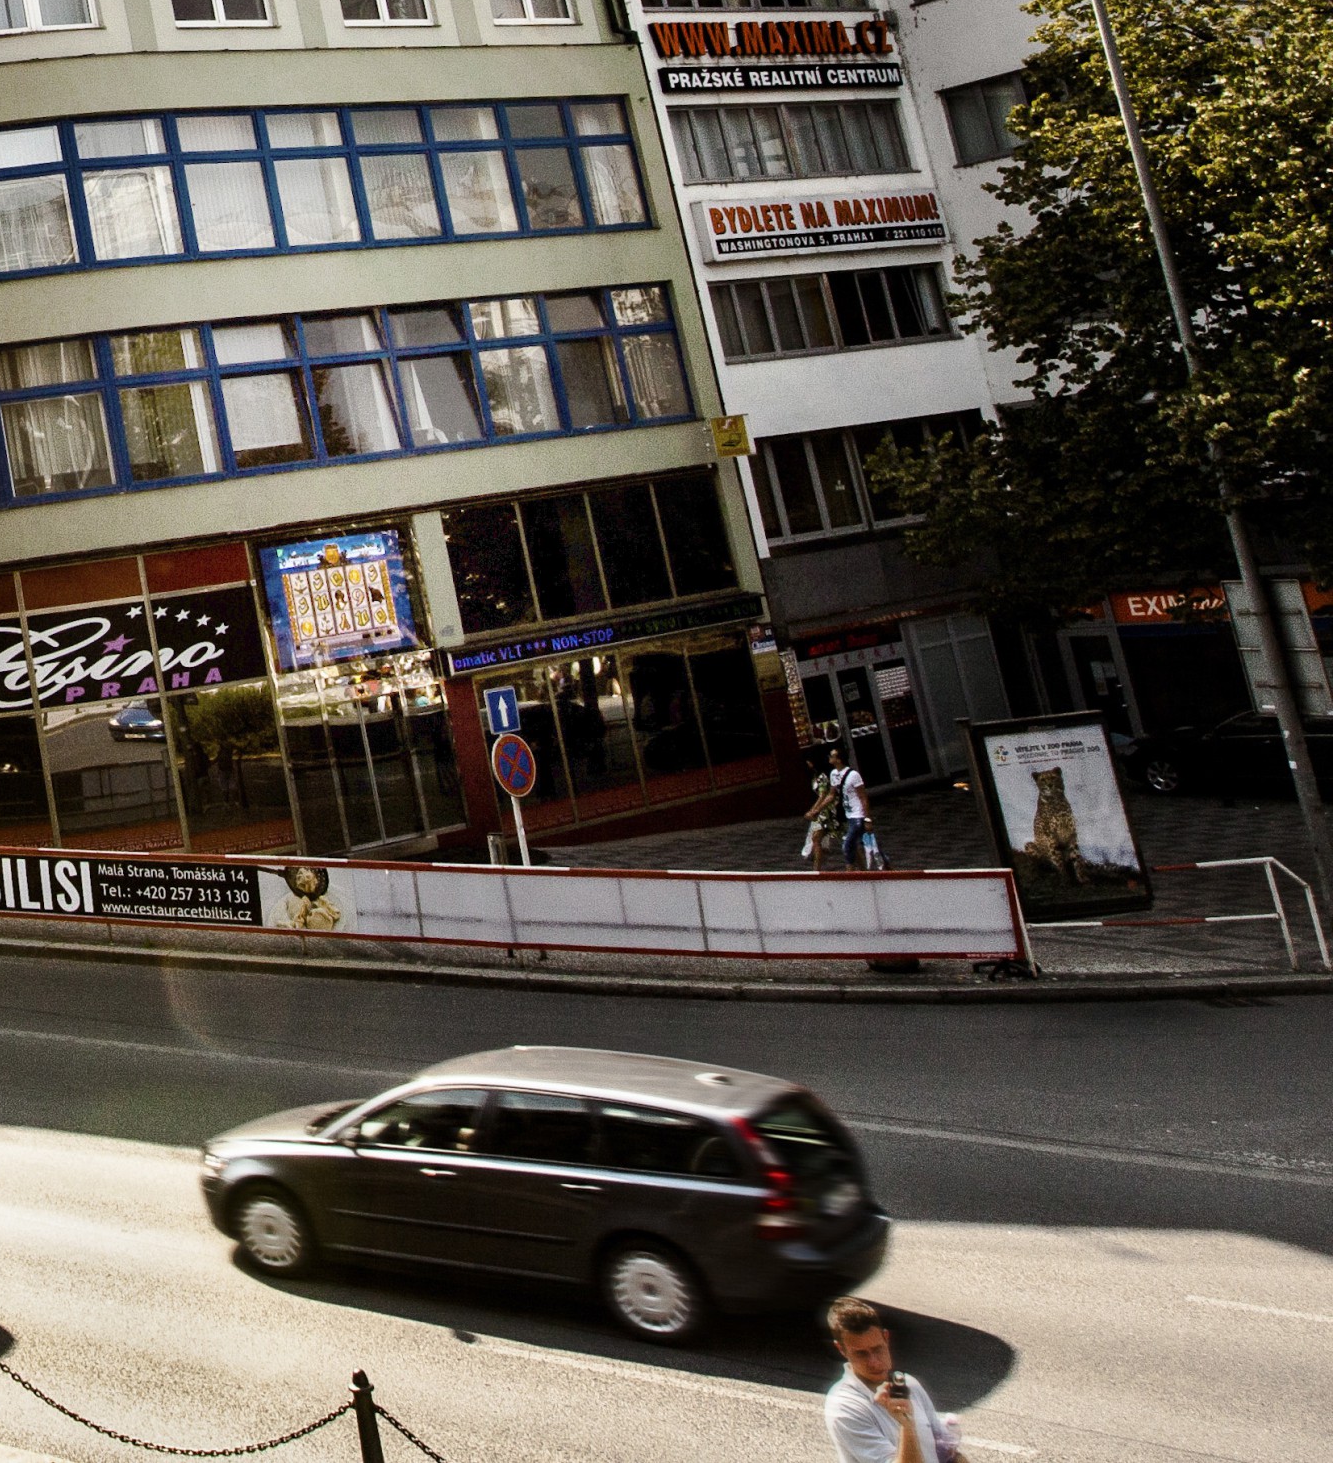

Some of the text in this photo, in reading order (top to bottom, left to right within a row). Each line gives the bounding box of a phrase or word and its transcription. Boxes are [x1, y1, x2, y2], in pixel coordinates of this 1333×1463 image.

[648, 20, 894, 57] WWW.MAXIMA.CZ
[668, 66, 900, 89] PRAŽSKÉ REALITNÍ CENTRUM
[709, 192, 940, 235] BYDLETE NA MAXIMUM!
[720, 236, 816, 253] WASHINGTONOVA
[833, 233, 867, 244] PRAHA
[499, 644, 523, 661] VLT
[551, 628, 615, 651] NON-STOP
[65, 667, 224, 703] PRAHA
[98, 864, 250, 884] Malá Strana, Tomášská 14,
[100, 883, 250, 904] Tel.: +420 257 313 130
[102, 903, 252, 921] www.restauracetbilisi.cz
